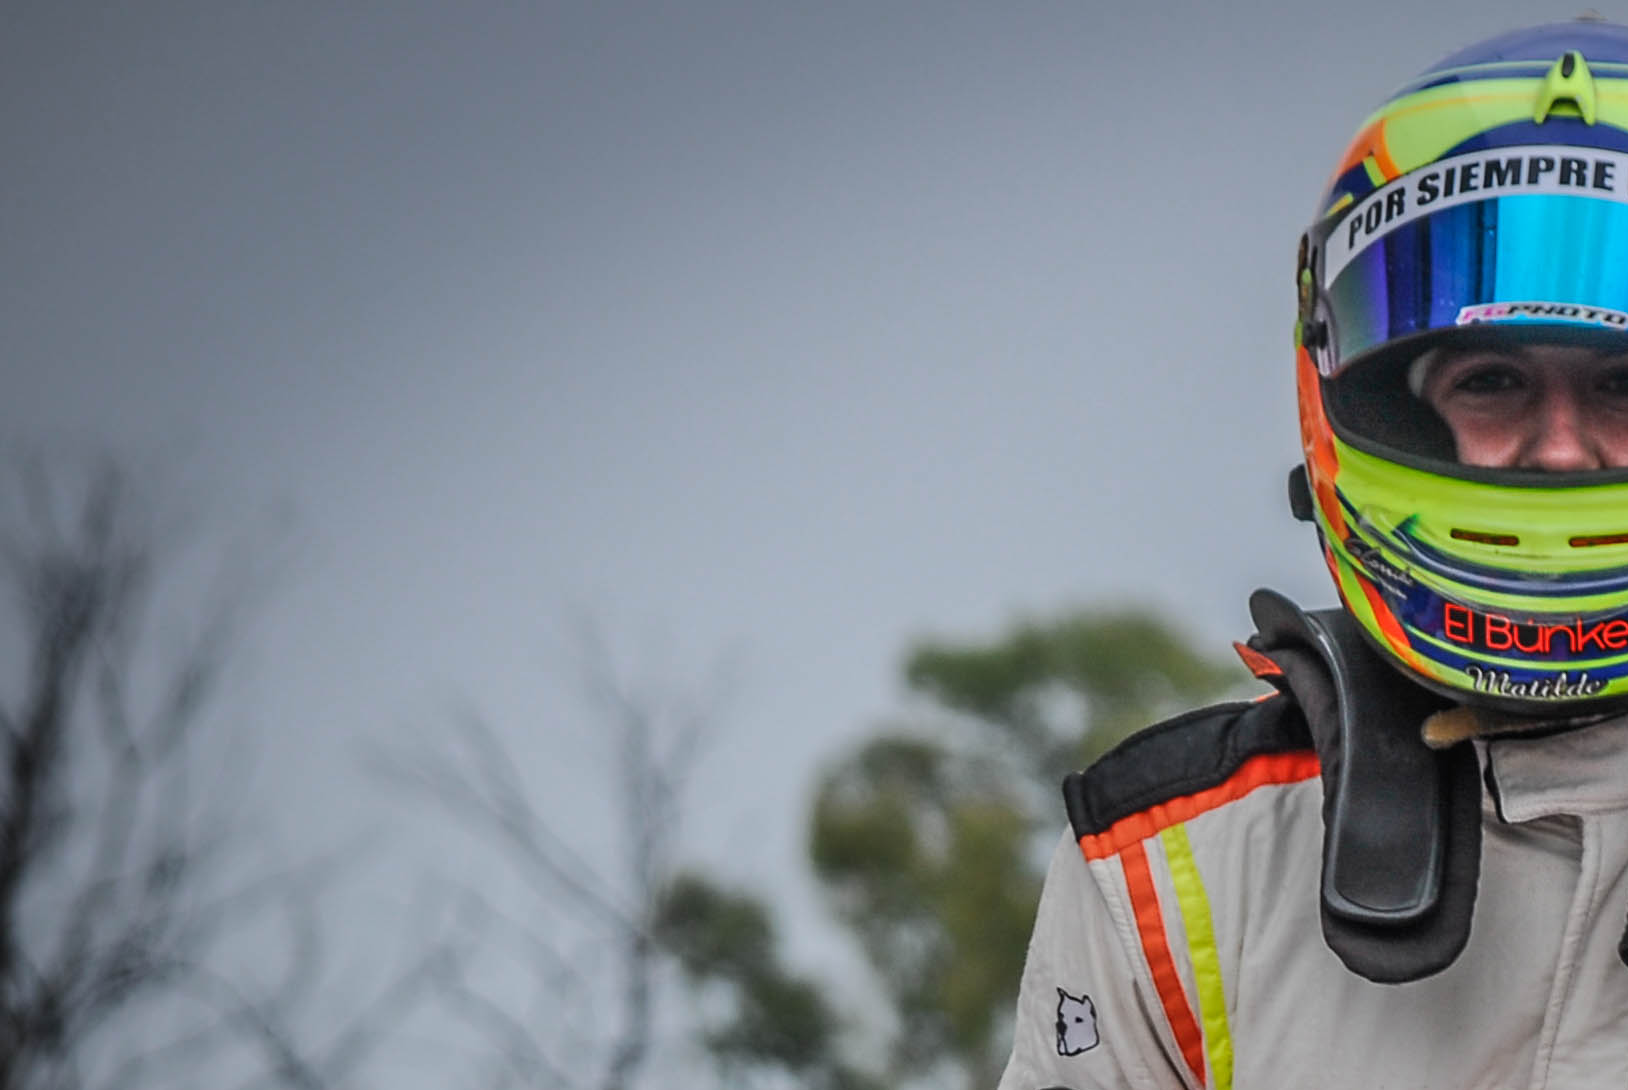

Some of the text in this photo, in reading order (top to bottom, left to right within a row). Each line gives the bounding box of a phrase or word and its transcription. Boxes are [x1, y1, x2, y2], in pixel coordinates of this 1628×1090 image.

[1347, 186, 1405, 249] POR
[1417, 156, 1616, 205] SIEMPRE
[1444, 605, 1474, 641] El
[1465, 665, 1602, 701] Matilde
